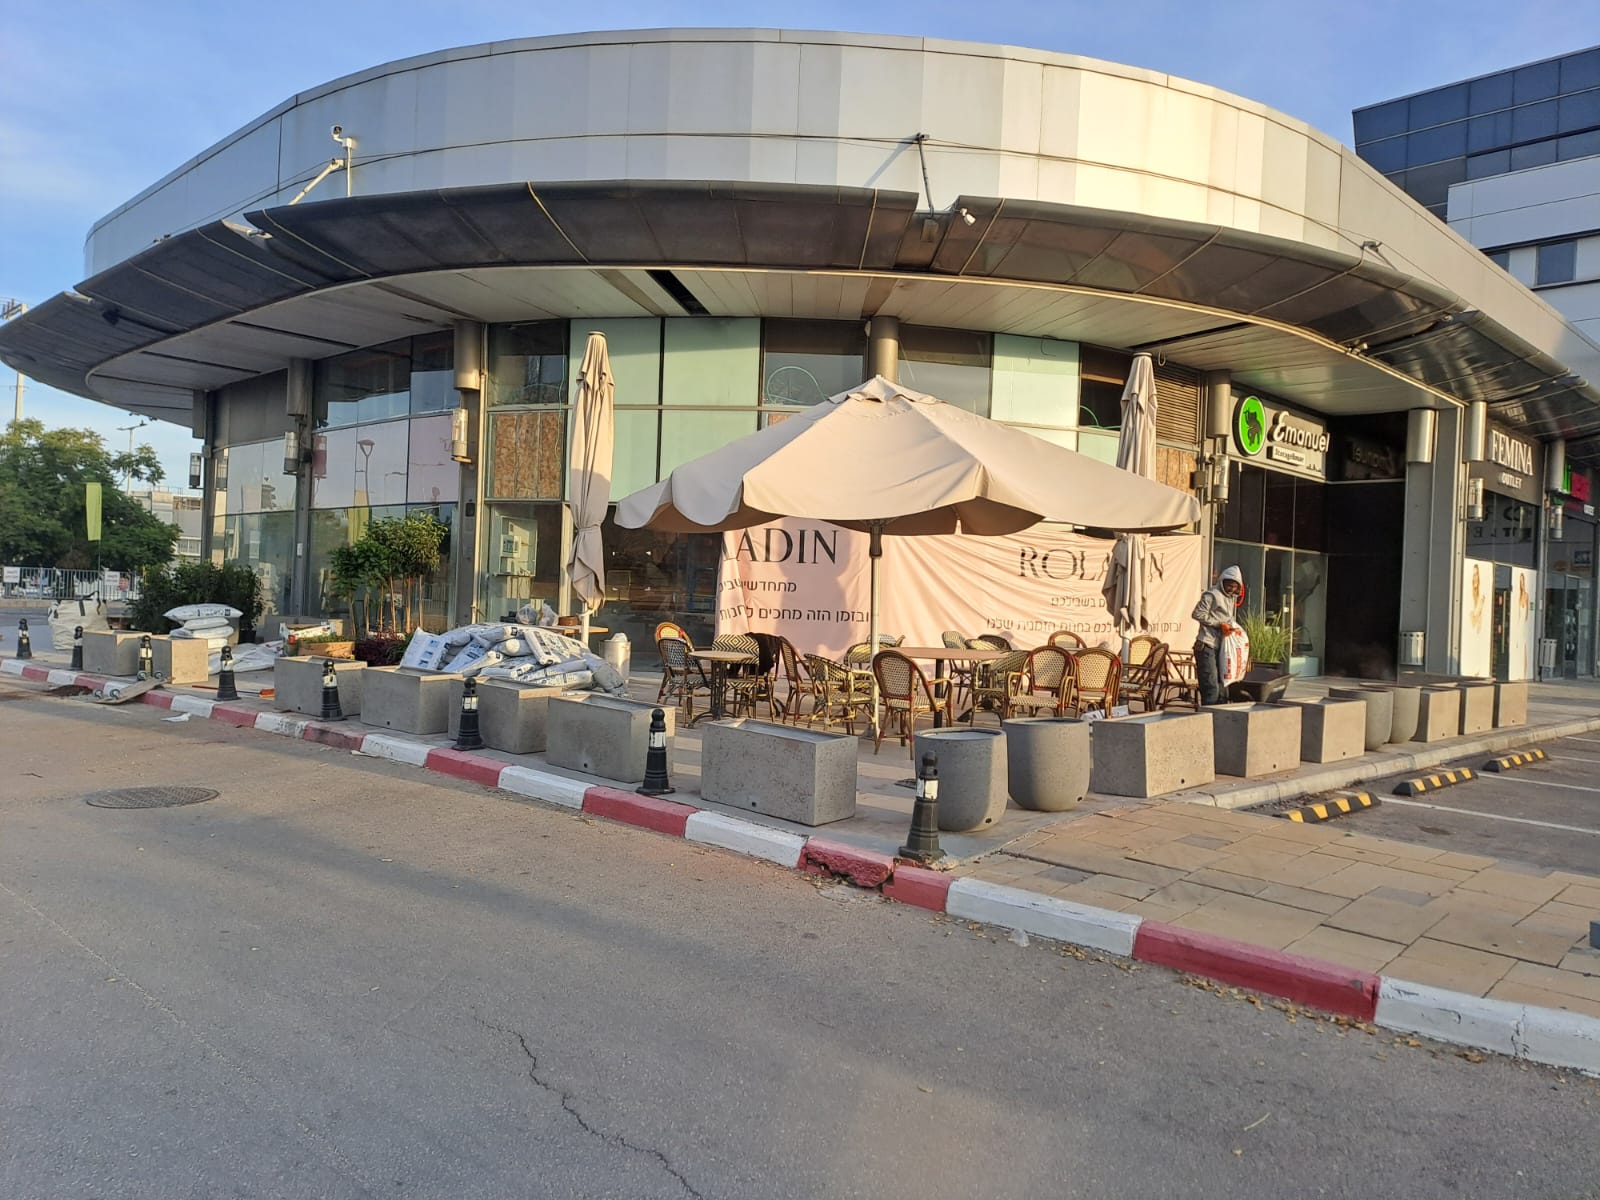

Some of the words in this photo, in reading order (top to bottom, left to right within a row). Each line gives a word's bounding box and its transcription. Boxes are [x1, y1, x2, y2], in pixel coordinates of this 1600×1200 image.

[1272, 411, 1331, 453] Emanuel
[1491, 429, 1534, 477] FEMINA
[1500, 472, 1523, 489] OUTLET
[758, 608, 803, 621] מחכים
[806, 609, 831, 622] הזה
[836, 610, 870, 623] ובזמן
